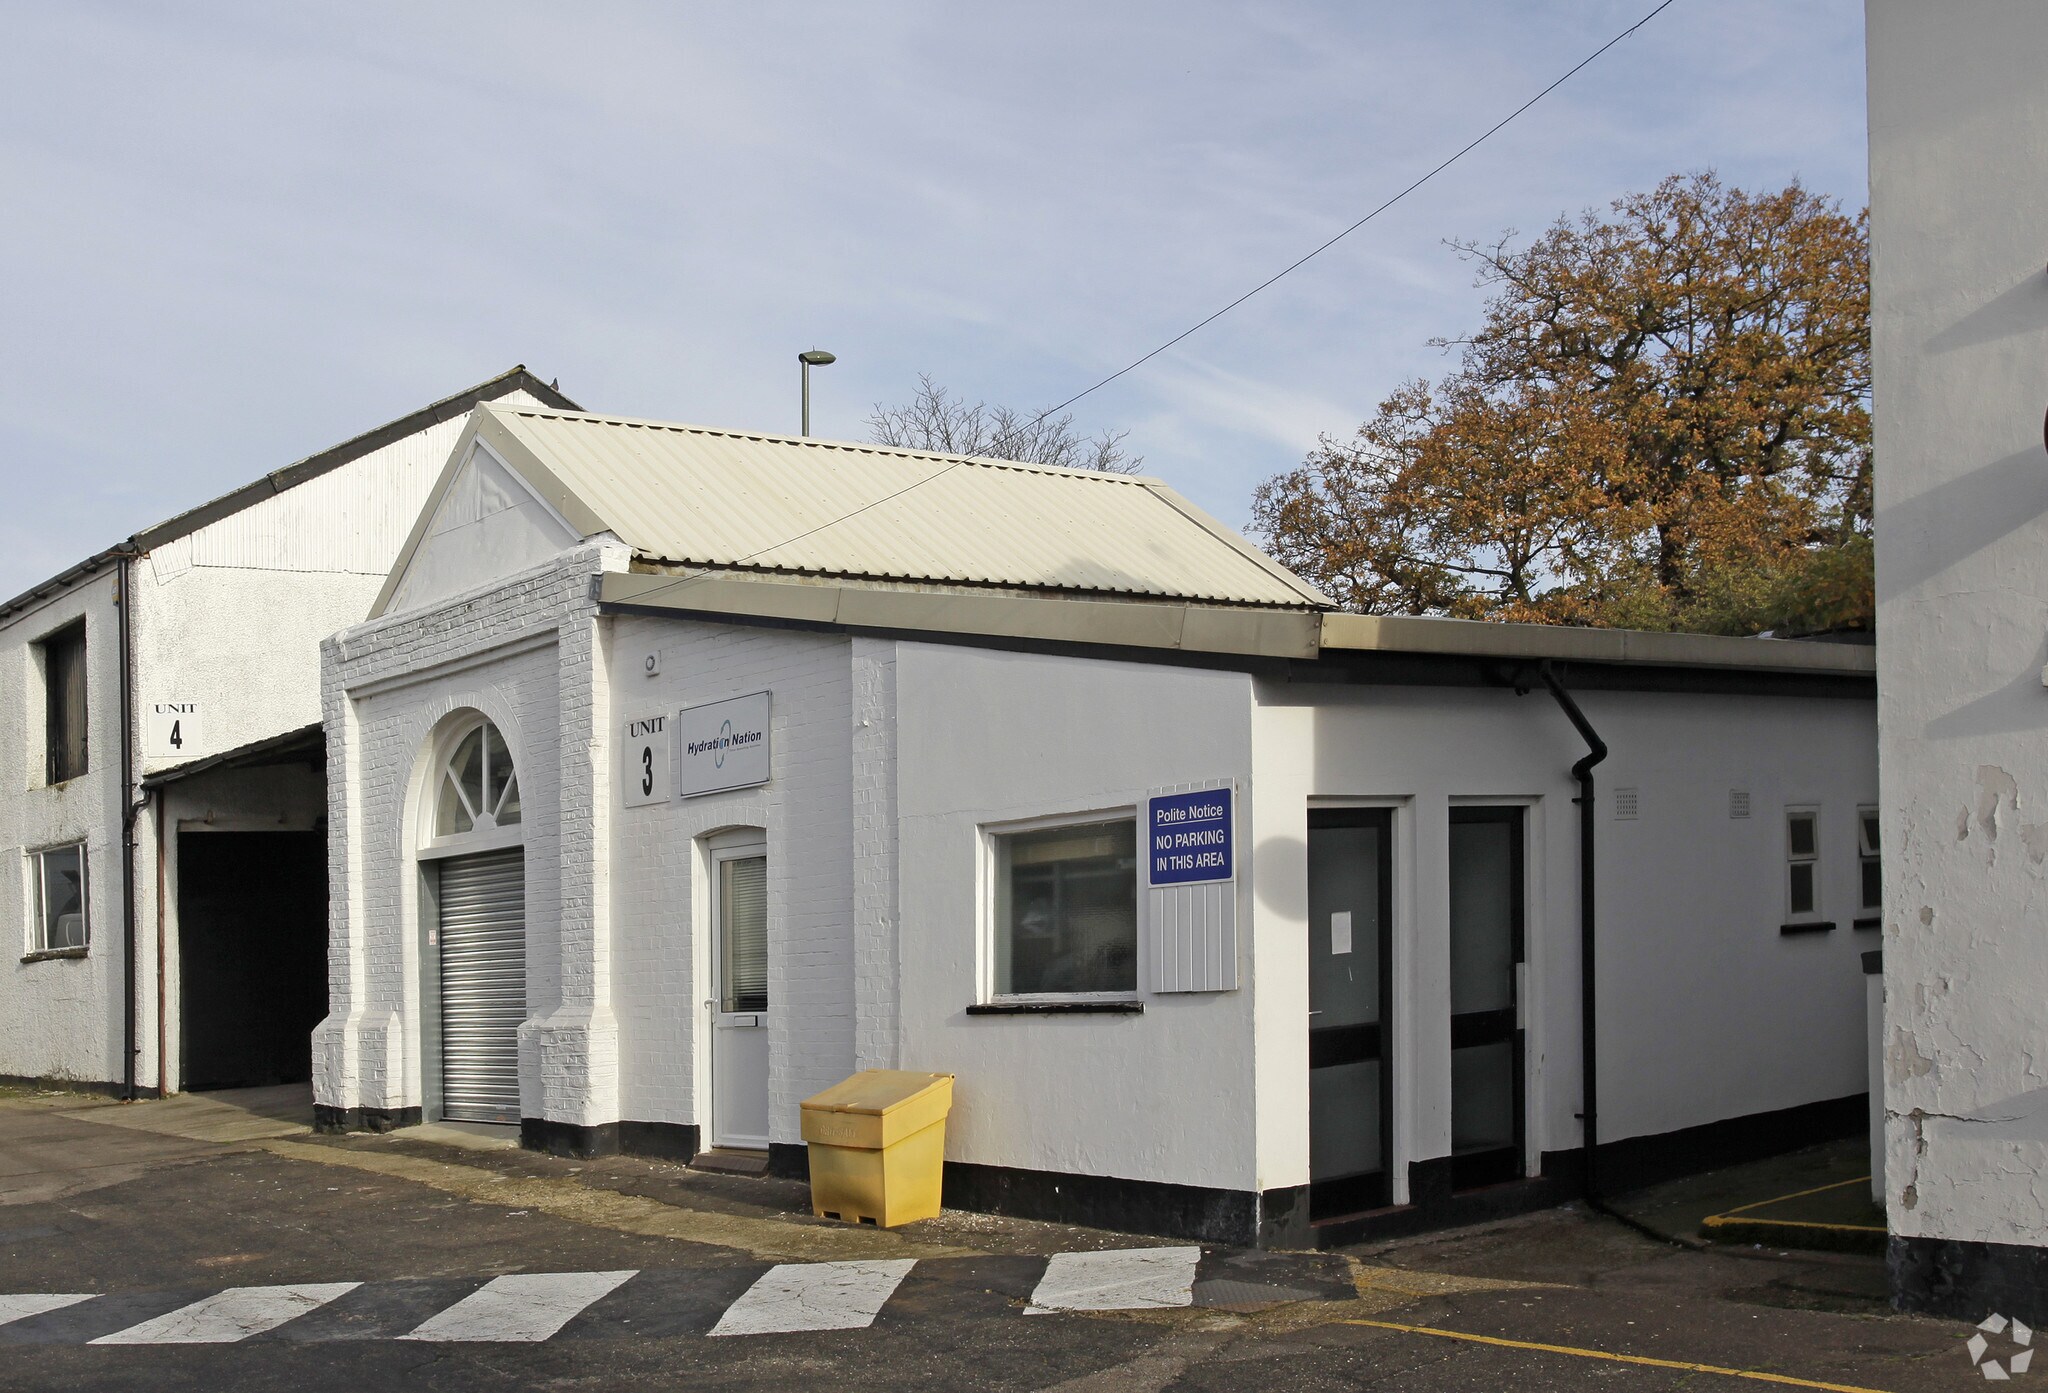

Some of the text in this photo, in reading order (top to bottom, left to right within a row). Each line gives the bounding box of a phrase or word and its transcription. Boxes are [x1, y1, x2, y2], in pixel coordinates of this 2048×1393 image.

[154, 703, 198, 714] UNIT
[170, 719, 183, 750] 4
[630, 716, 665, 737] UNIT
[687, 737, 730, 756] Hydration
[731, 730, 762, 746] Nation
[642, 746, 653, 796] 3
[1156, 804, 1223, 823] Polite Notice
[1156, 829, 1225, 850] NO PARKING
[1156, 852, 1225, 872] IN THIS AREA
